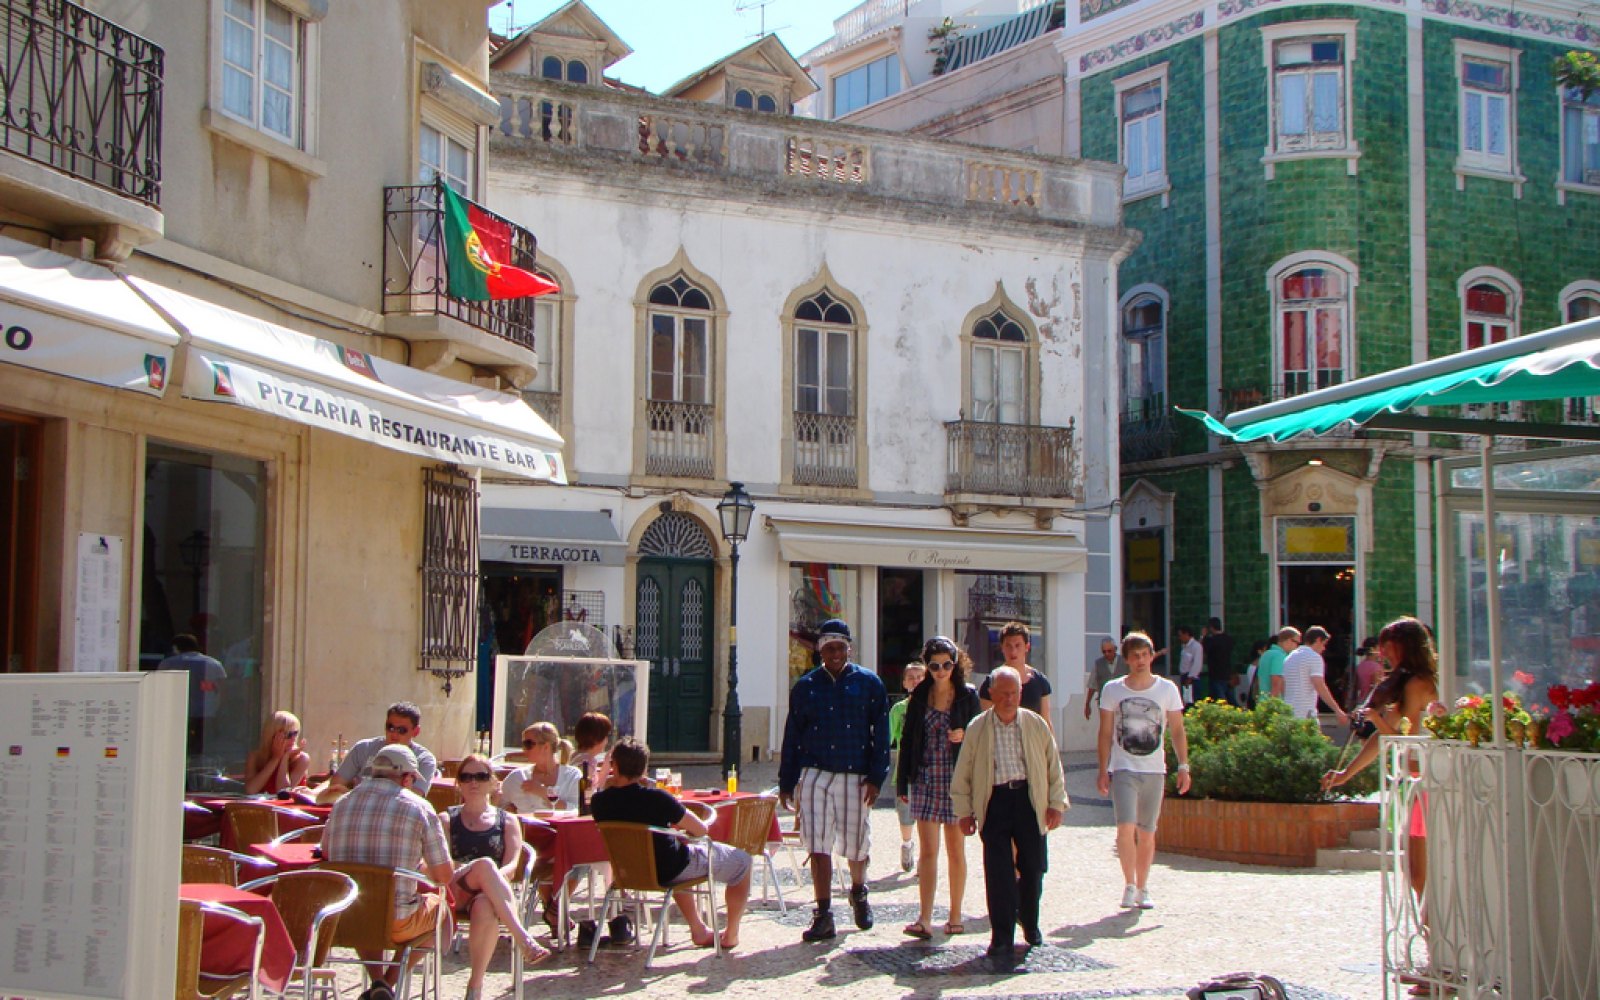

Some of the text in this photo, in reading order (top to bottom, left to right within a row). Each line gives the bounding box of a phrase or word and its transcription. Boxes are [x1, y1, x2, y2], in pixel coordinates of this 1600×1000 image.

[0, 324, 33, 350] O
[257, 380, 537, 470] PIZZARIA RESTAURANTE BAR
[510, 544, 601, 562] TERRACOTA
[907, 550, 918, 563] O
